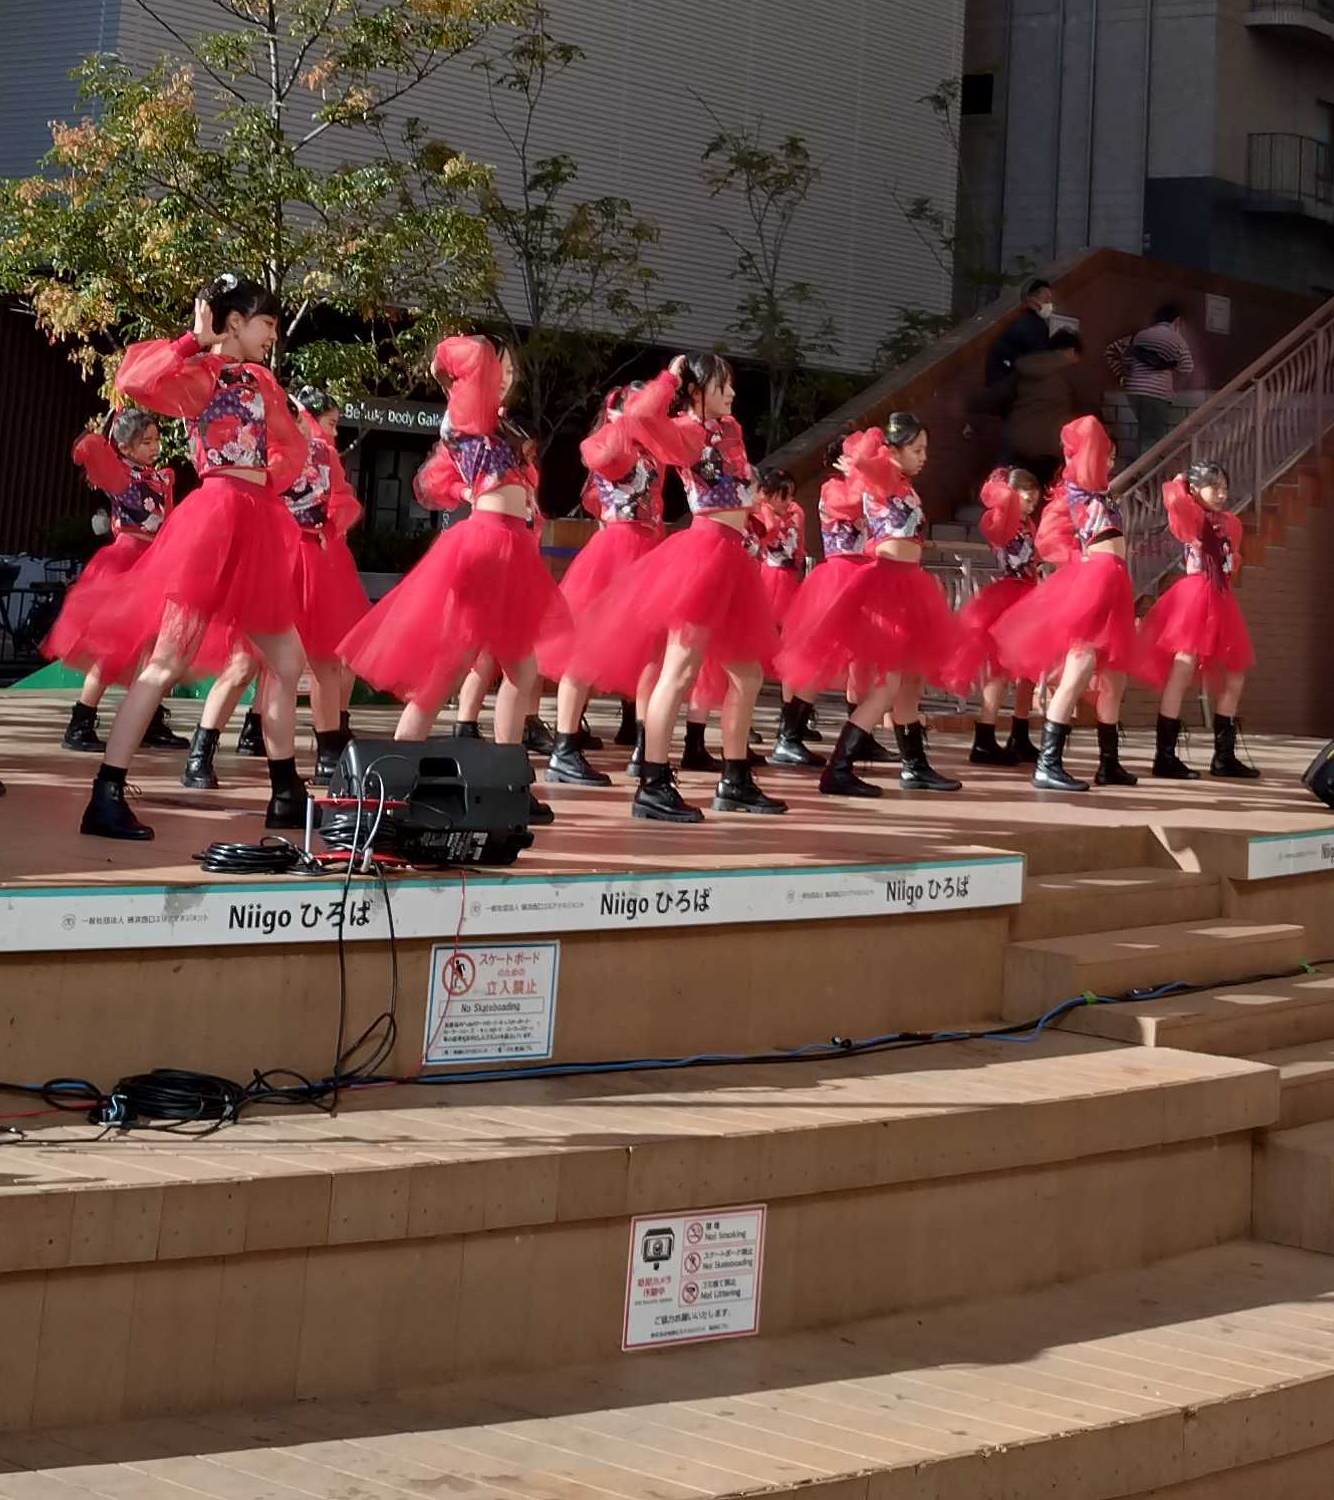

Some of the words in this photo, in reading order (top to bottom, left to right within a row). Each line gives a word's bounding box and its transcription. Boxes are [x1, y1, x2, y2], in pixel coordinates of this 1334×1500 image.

[886, 880, 924, 906] Niigo
[927, 874, 971, 900] ひろば
[600, 892, 650, 920] Niigo
[655, 886, 713, 914] ひろば
[228, 904, 292, 935] Niigo
[299, 899, 373, 928] ひろば
[478, 952, 540, 966] スケートボード
[484, 979, 537, 996] 立入禁止
[460, 1003, 471, 1013] No
